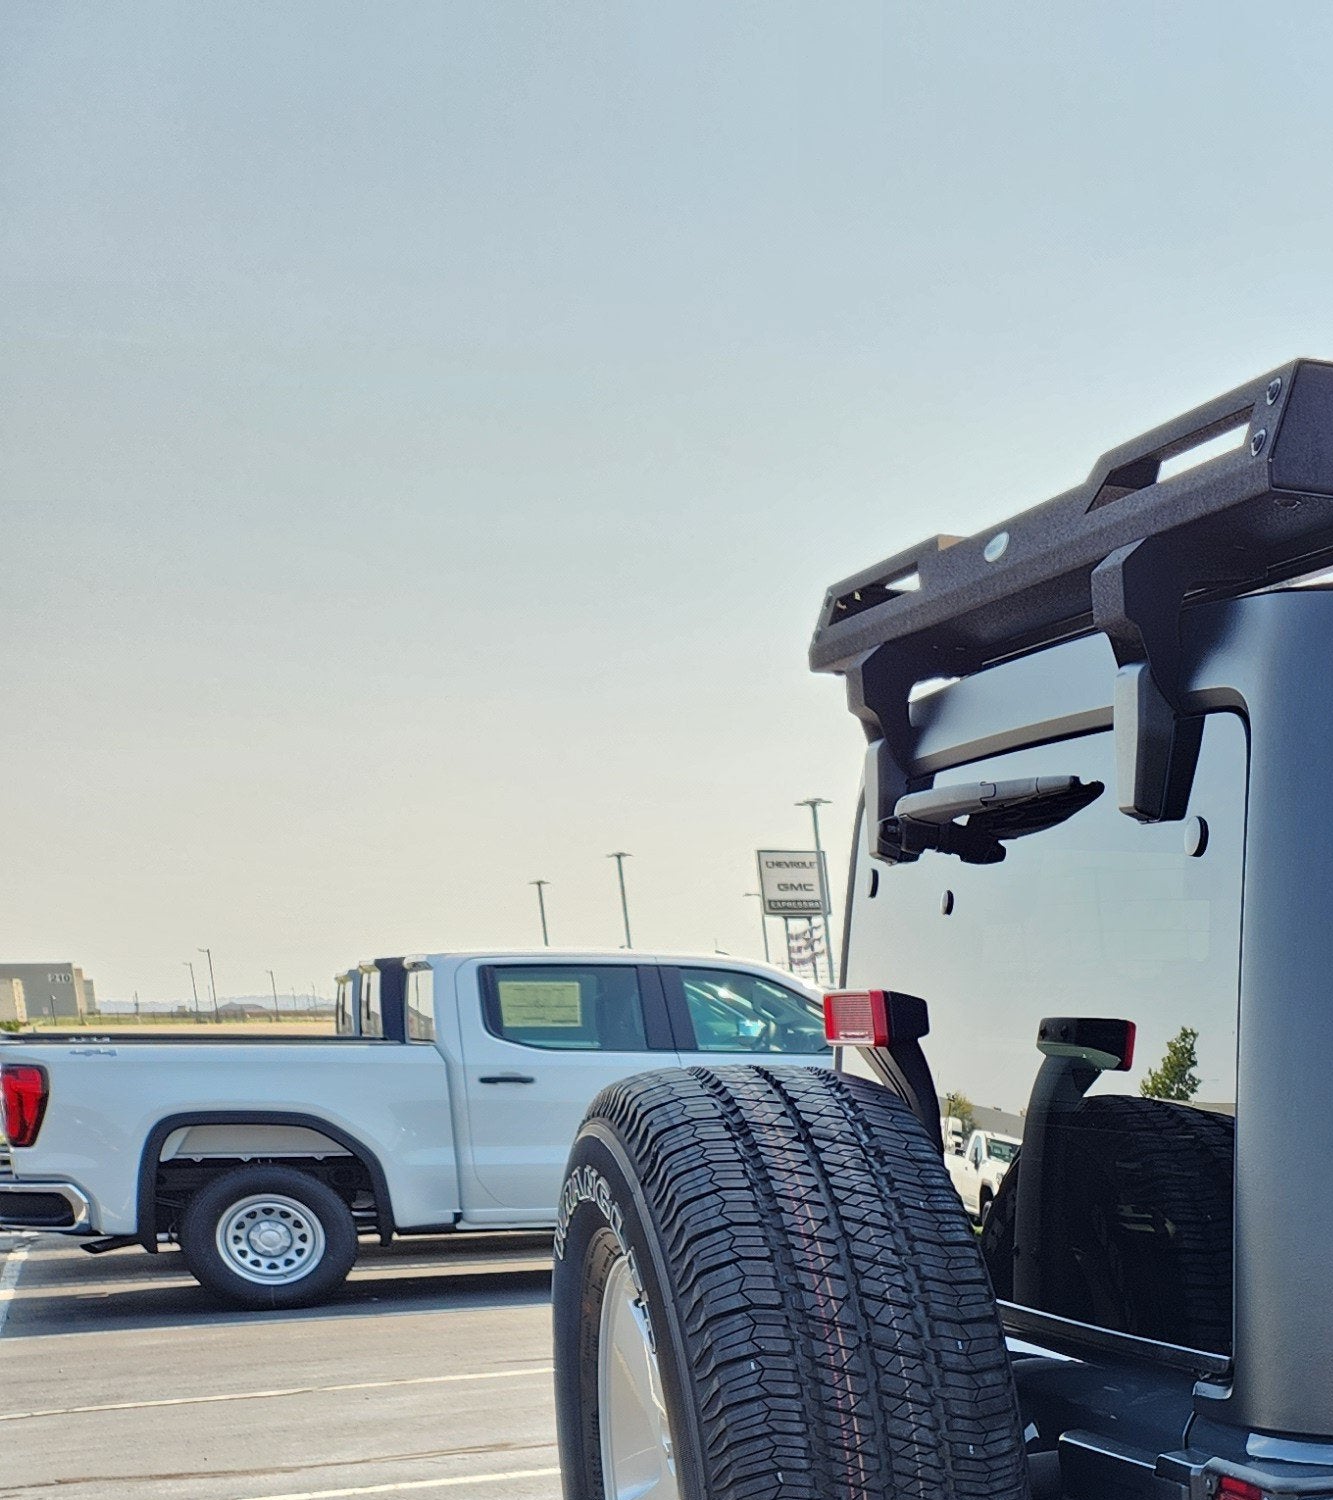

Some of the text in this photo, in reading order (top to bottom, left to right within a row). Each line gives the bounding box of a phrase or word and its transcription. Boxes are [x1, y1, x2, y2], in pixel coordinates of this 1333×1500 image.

[765, 860, 817, 869] CHEVROLE
[777, 883, 815, 892] GMC
[770, 901, 821, 909] EXPRESSWA
